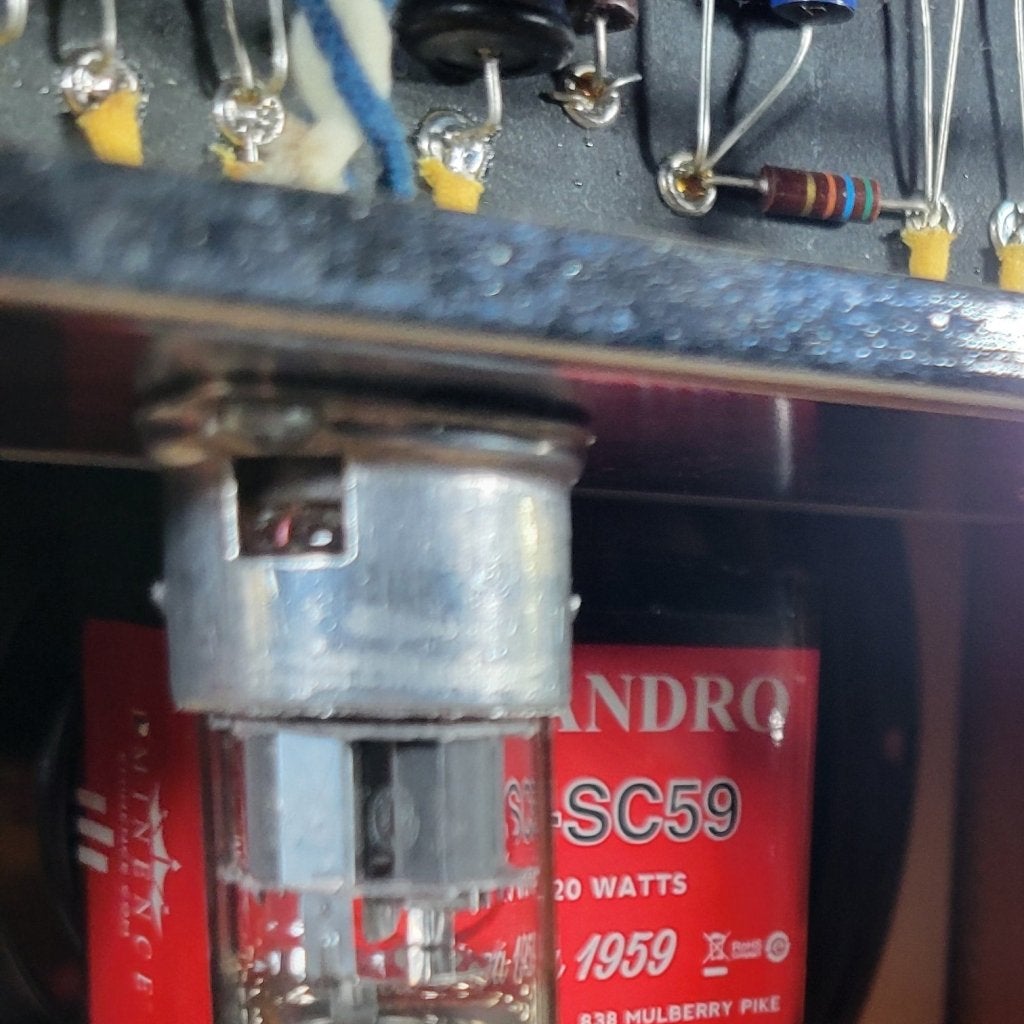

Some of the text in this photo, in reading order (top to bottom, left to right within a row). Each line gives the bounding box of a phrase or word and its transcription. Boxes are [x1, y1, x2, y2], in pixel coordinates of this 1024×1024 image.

[589, 872, 687, 899] WATTS
[576, 928, 678, 981] 1959
[739, 996, 782, 1015] PIKE
